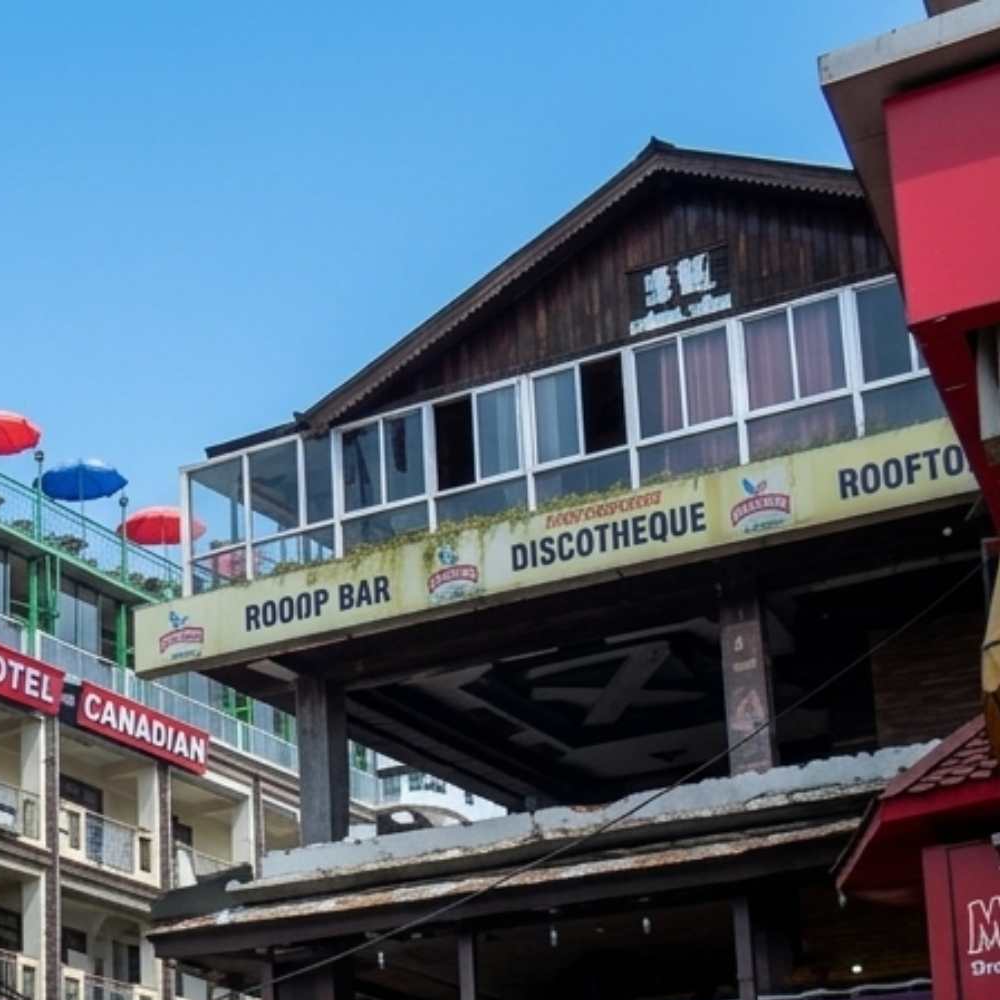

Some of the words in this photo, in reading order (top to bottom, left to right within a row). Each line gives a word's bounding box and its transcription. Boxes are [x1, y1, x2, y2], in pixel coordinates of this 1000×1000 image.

[838, 443, 972, 499] ROOFTO
[511, 502, 707, 571] DISCOTHEQUE
[338, 575, 391, 612] BAR
[83, 693, 206, 764] CANADIAN
